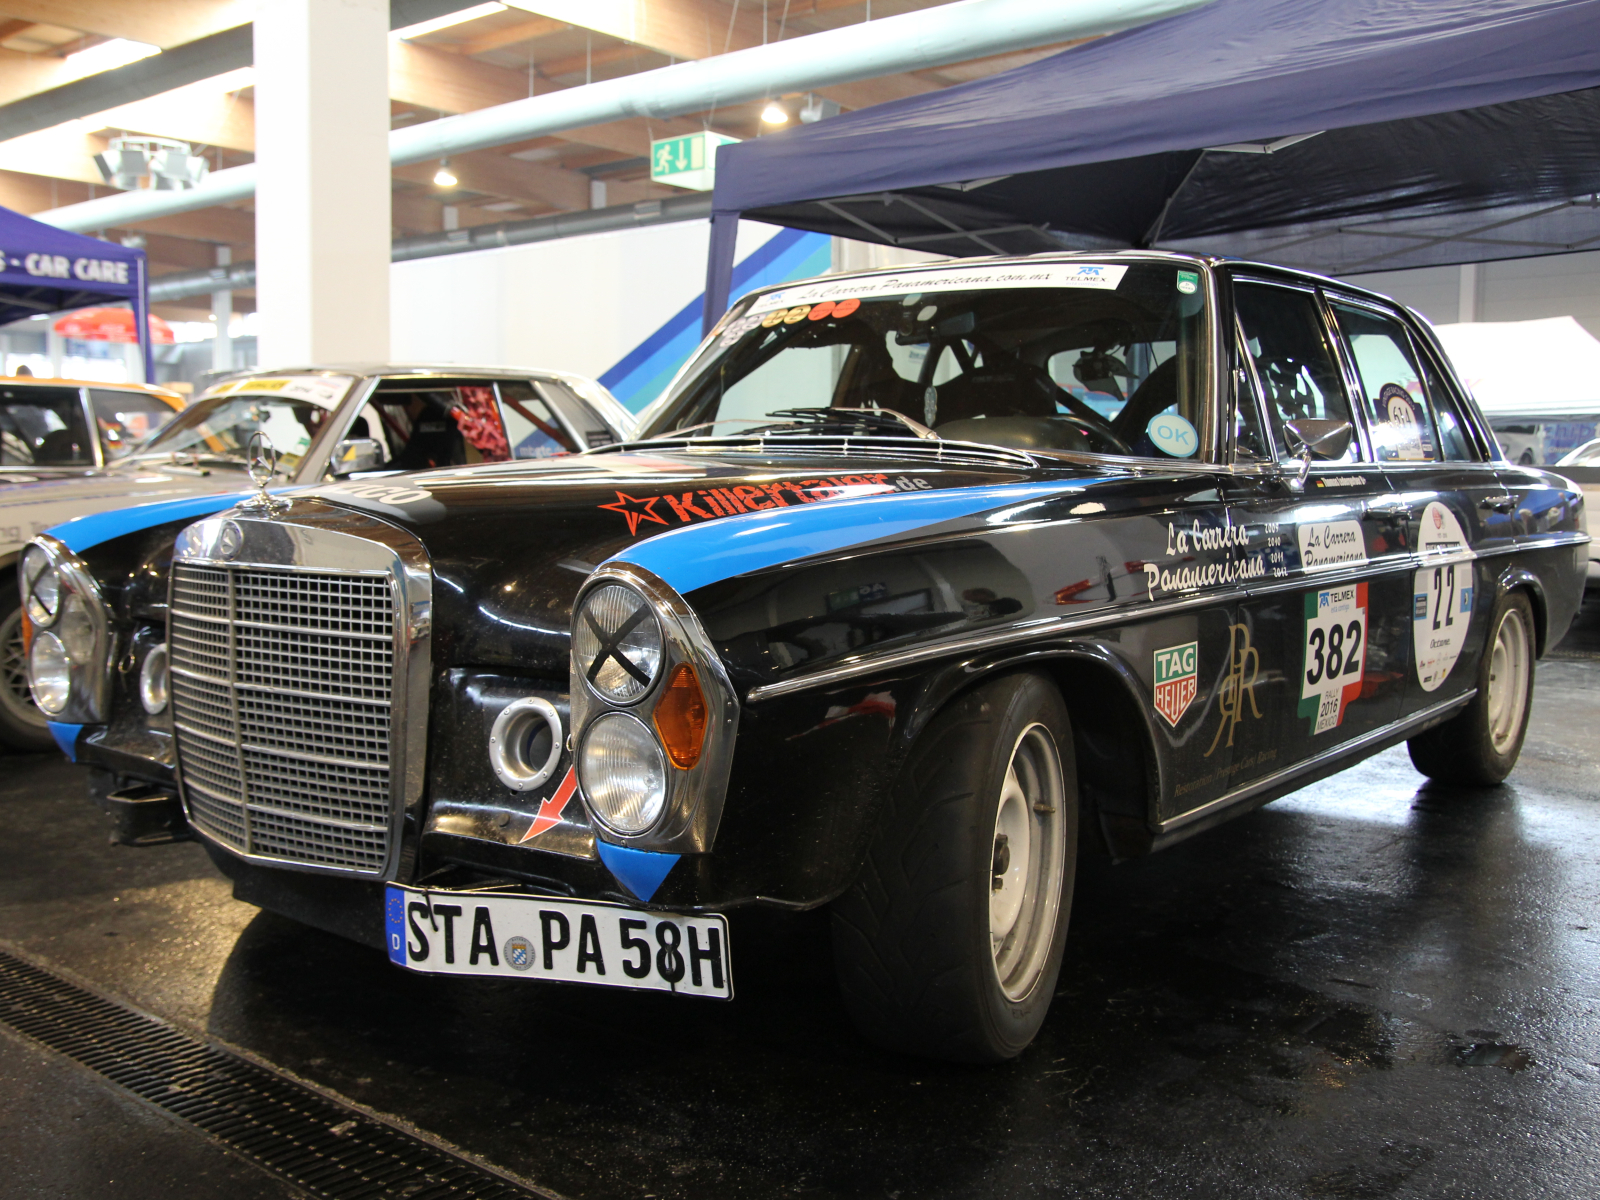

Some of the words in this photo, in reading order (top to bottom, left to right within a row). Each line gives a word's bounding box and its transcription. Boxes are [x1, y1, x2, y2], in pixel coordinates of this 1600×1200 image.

[25, 253, 71, 279] CAR
[74, 257, 129, 285] CARE
[797, 283, 815, 300] La
[820, 281, 876, 298] Carrera
[880, 272, 1053, 290] Panamericana.com.mx
[1157, 425, 1190, 446] OK
[1166, 521, 1189, 556] La
[1193, 519, 1249, 552] Carrera
[1264, 523, 1279, 534] 2009
[1308, 527, 1321, 547] La
[1324, 525, 1356, 549] Carrera
[1267, 537, 1281, 547] 2010
[1270, 552, 1284, 563] 2011
[1143, 553, 1265, 601] Panamericana
[1273, 567, 1288, 578] 2012
[1330, 590, 1355, 603] TELMEX
[1433, 564, 1455, 631] 22
[1158, 648, 1194, 679] TAG
[1306, 620, 1362, 685] 382
[1157, 679, 1195, 720] HEUER
[1325, 687, 1340, 700] RALLY
[1320, 699, 1339, 717] 2016
[1174, 774, 1213, 797] Restoration
[392, 933, 400, 950] D
[408, 901, 499, 966] STA
[538, 910, 606, 976] PA
[619, 917, 724, 989] 58H
